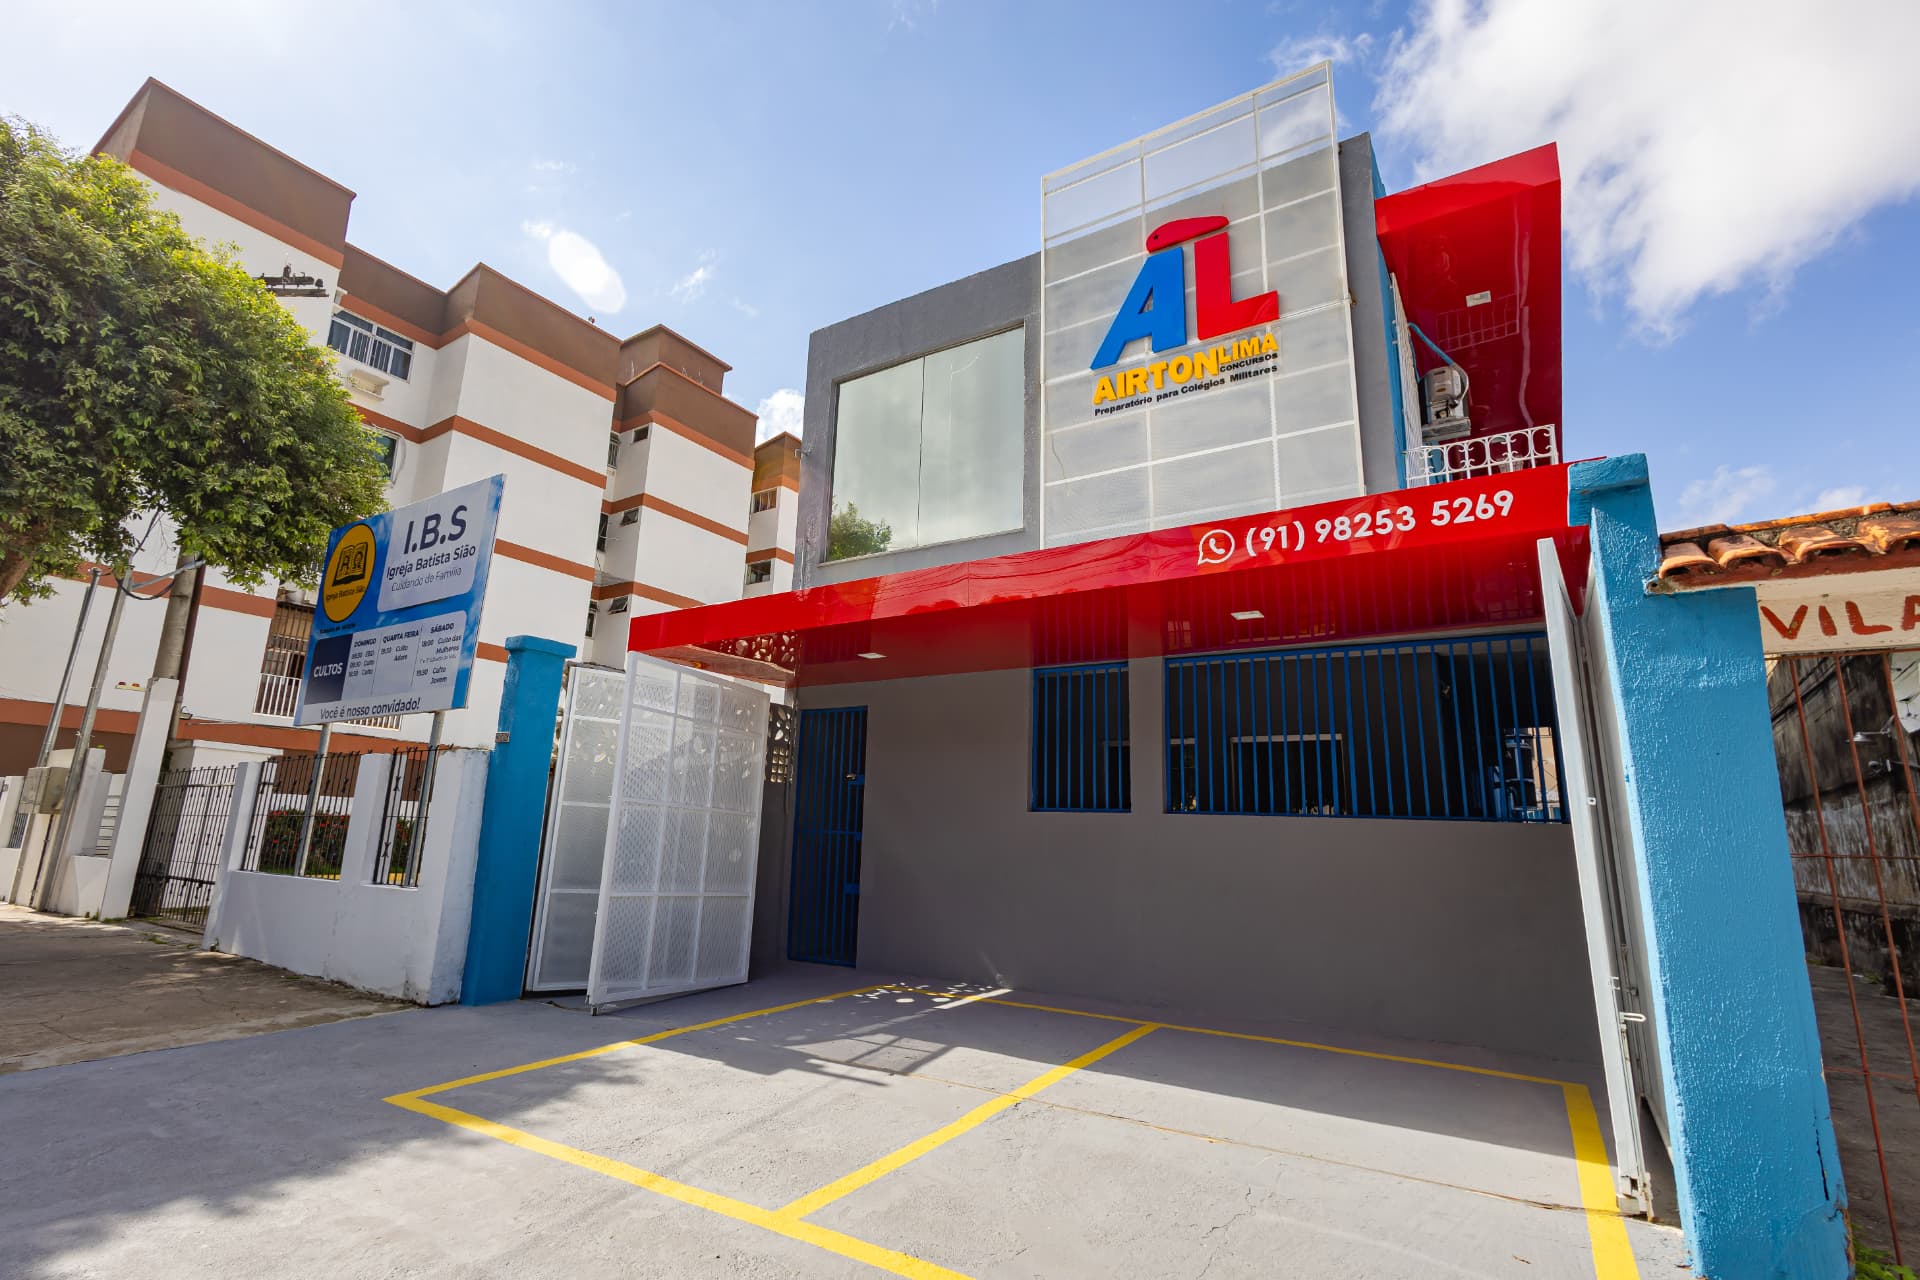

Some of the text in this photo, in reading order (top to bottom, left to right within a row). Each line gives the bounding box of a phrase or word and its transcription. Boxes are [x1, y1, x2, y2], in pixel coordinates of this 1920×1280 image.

[1093, 332, 1279, 405] AIRTON LIMA
[1219, 352, 1279, 373] CONCURSOS
[1094, 365, 1278, 416] Preparatório para Colégios Militares
[403, 505, 468, 554] I.B.S
[1246, 490, 1514, 557] (91) 98253 5269
[386, 544, 476, 581] Igreja Batista Sião
[382, 629, 419, 643] QUARTA FEIRA
[430, 622, 455, 634] SÁBADO
[313, 662, 344, 678] CULTOS
[320, 697, 421, 720] Você é nosso convidado!
